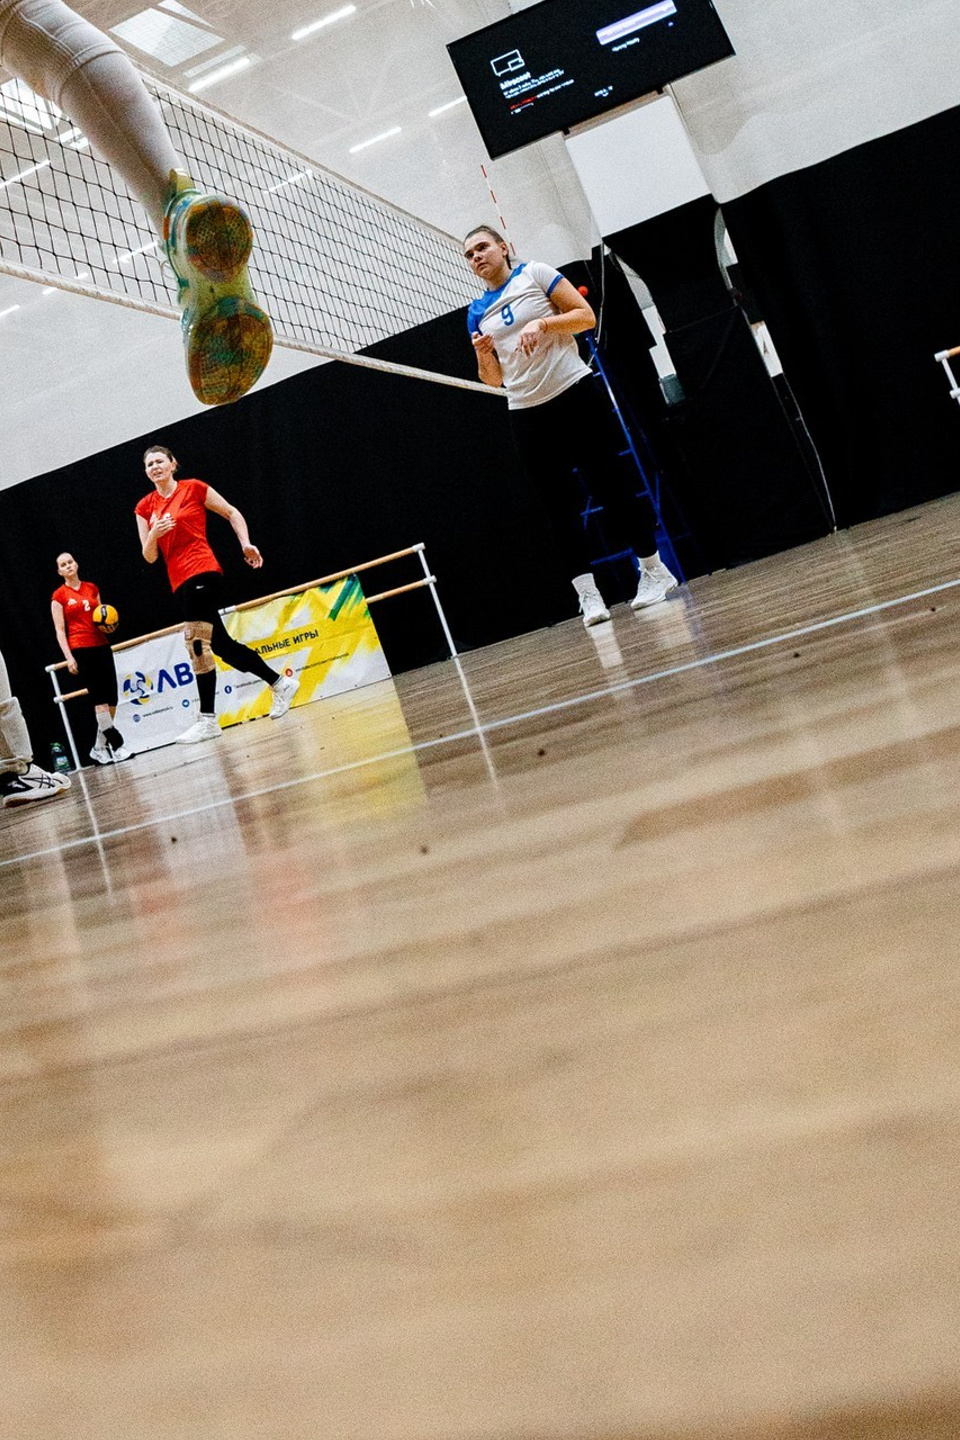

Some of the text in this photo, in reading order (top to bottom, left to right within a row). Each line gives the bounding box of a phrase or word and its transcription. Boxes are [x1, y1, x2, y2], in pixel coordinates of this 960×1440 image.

[501, 304, 515, 327] 9
[82, 599, 91, 612] 2
[255, 629, 319, 655] АЛЬНЫЕ ИГРЫ
[157, 662, 194, 693] ЛВ
